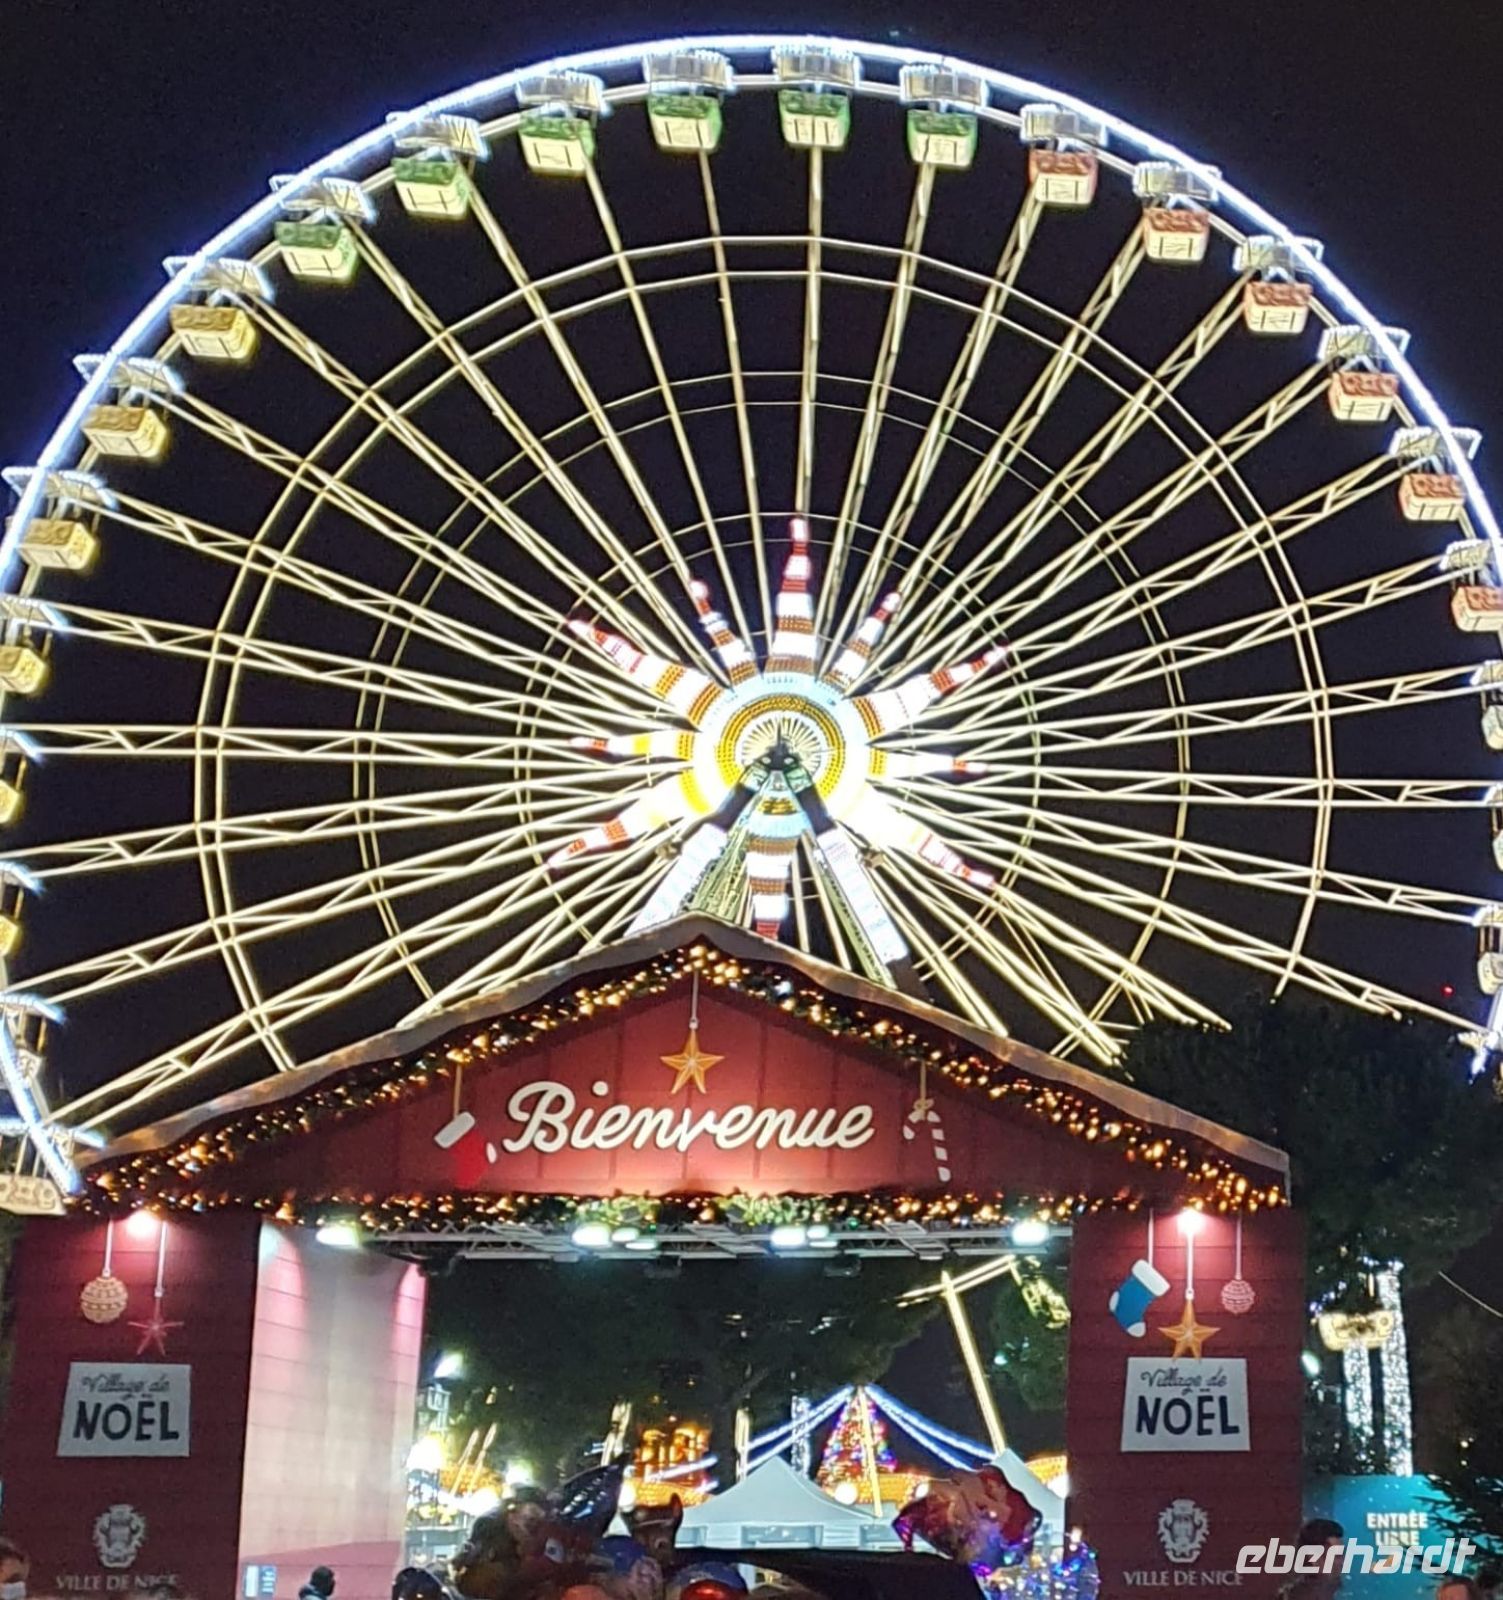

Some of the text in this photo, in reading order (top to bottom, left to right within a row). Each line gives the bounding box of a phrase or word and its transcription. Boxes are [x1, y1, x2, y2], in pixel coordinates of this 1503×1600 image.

[502, 1080, 876, 1153] Bienvenue
[82, 1373, 170, 1400] Village de
[1140, 1366, 1228, 1396] Village de
[72, 1394, 180, 1441] NOËL
[1136, 1388, 1240, 1436] NOËL
[1366, 1509, 1429, 1529] ENTRÉE
[1375, 1530, 1420, 1547] LIBRE
[56, 1574, 101, 1591] VILLE
[106, 1574, 129, 1591] DE
[1123, 1570, 1244, 1587] VILLE DE NICE
